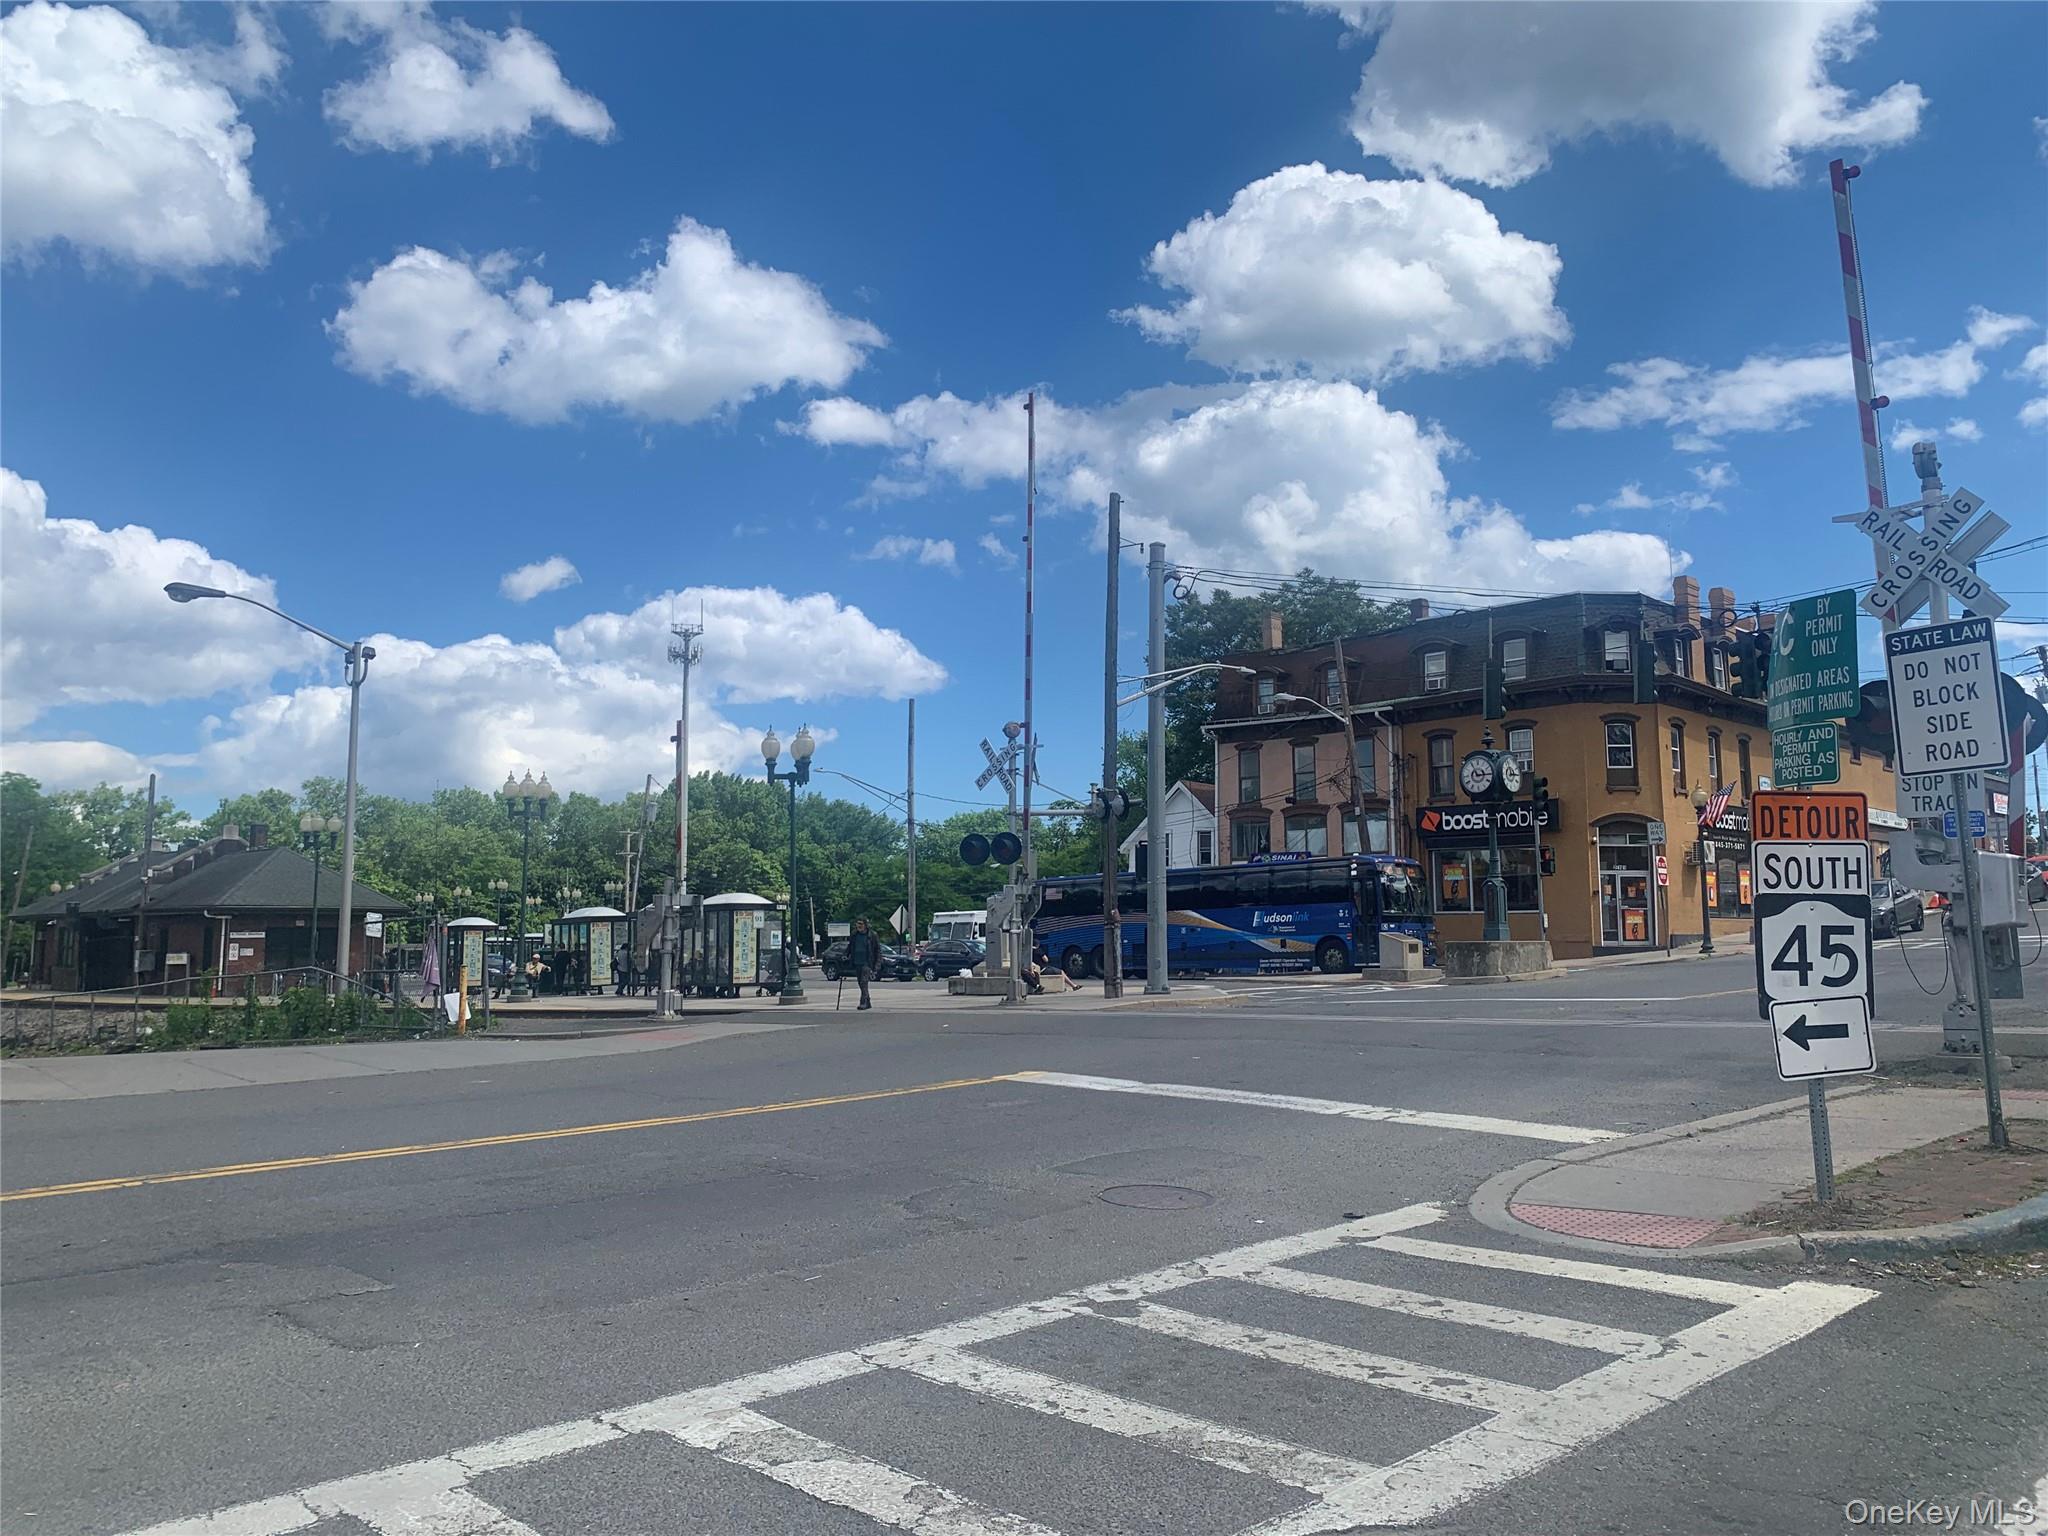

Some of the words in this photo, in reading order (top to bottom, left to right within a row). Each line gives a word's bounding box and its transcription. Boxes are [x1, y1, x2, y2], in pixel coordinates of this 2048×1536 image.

[1861, 511, 1906, 551] RAIL
[1928, 558, 1981, 600] ROAD
[1870, 498, 1972, 608] CROSSING
[1816, 596, 1831, 616] BY
[1805, 613, 1844, 637] PERMIT
[1891, 630, 1945, 651] STATE
[1950, 623, 1987, 642] LAW
[1811, 637, 1839, 657] ONLY
[1816, 665, 1850, 688] AREAS
[1904, 661, 1929, 681] DO
[1944, 652, 1981, 675] NOT
[1791, 696, 1815, 716] PERMIT
[1818, 690, 1854, 712] PARKING
[1913, 681, 1980, 708] BLOCK
[1926, 711, 1973, 734] SIDE
[1774, 730, 1802, 747] HOURLY
[1808, 727, 1834, 742] AND
[1782, 740, 1819, 757] PERMIT
[1774, 752, 1811, 769] PARKING
[1817, 752, 1835, 765] AS
[1925, 739, 1980, 762] ROAD
[976, 743, 1017, 787] CROSSING
[980, 741, 996, 761] RAIL
[998, 768, 1013, 793] ROAD
[1782, 764, 1823, 781] POSTED
[1902, 774, 1944, 793] STOP
[1911, 795, 1956, 812] TRAC
[1441, 809, 1490, 831] boost
[1495, 806, 1549, 828] mobie
[1760, 805, 1860, 839] DETOUR
[1271, 853, 1297, 862] SINAI
[1762, 852, 1863, 890] SOUTH
[1770, 924, 1860, 989] 45
